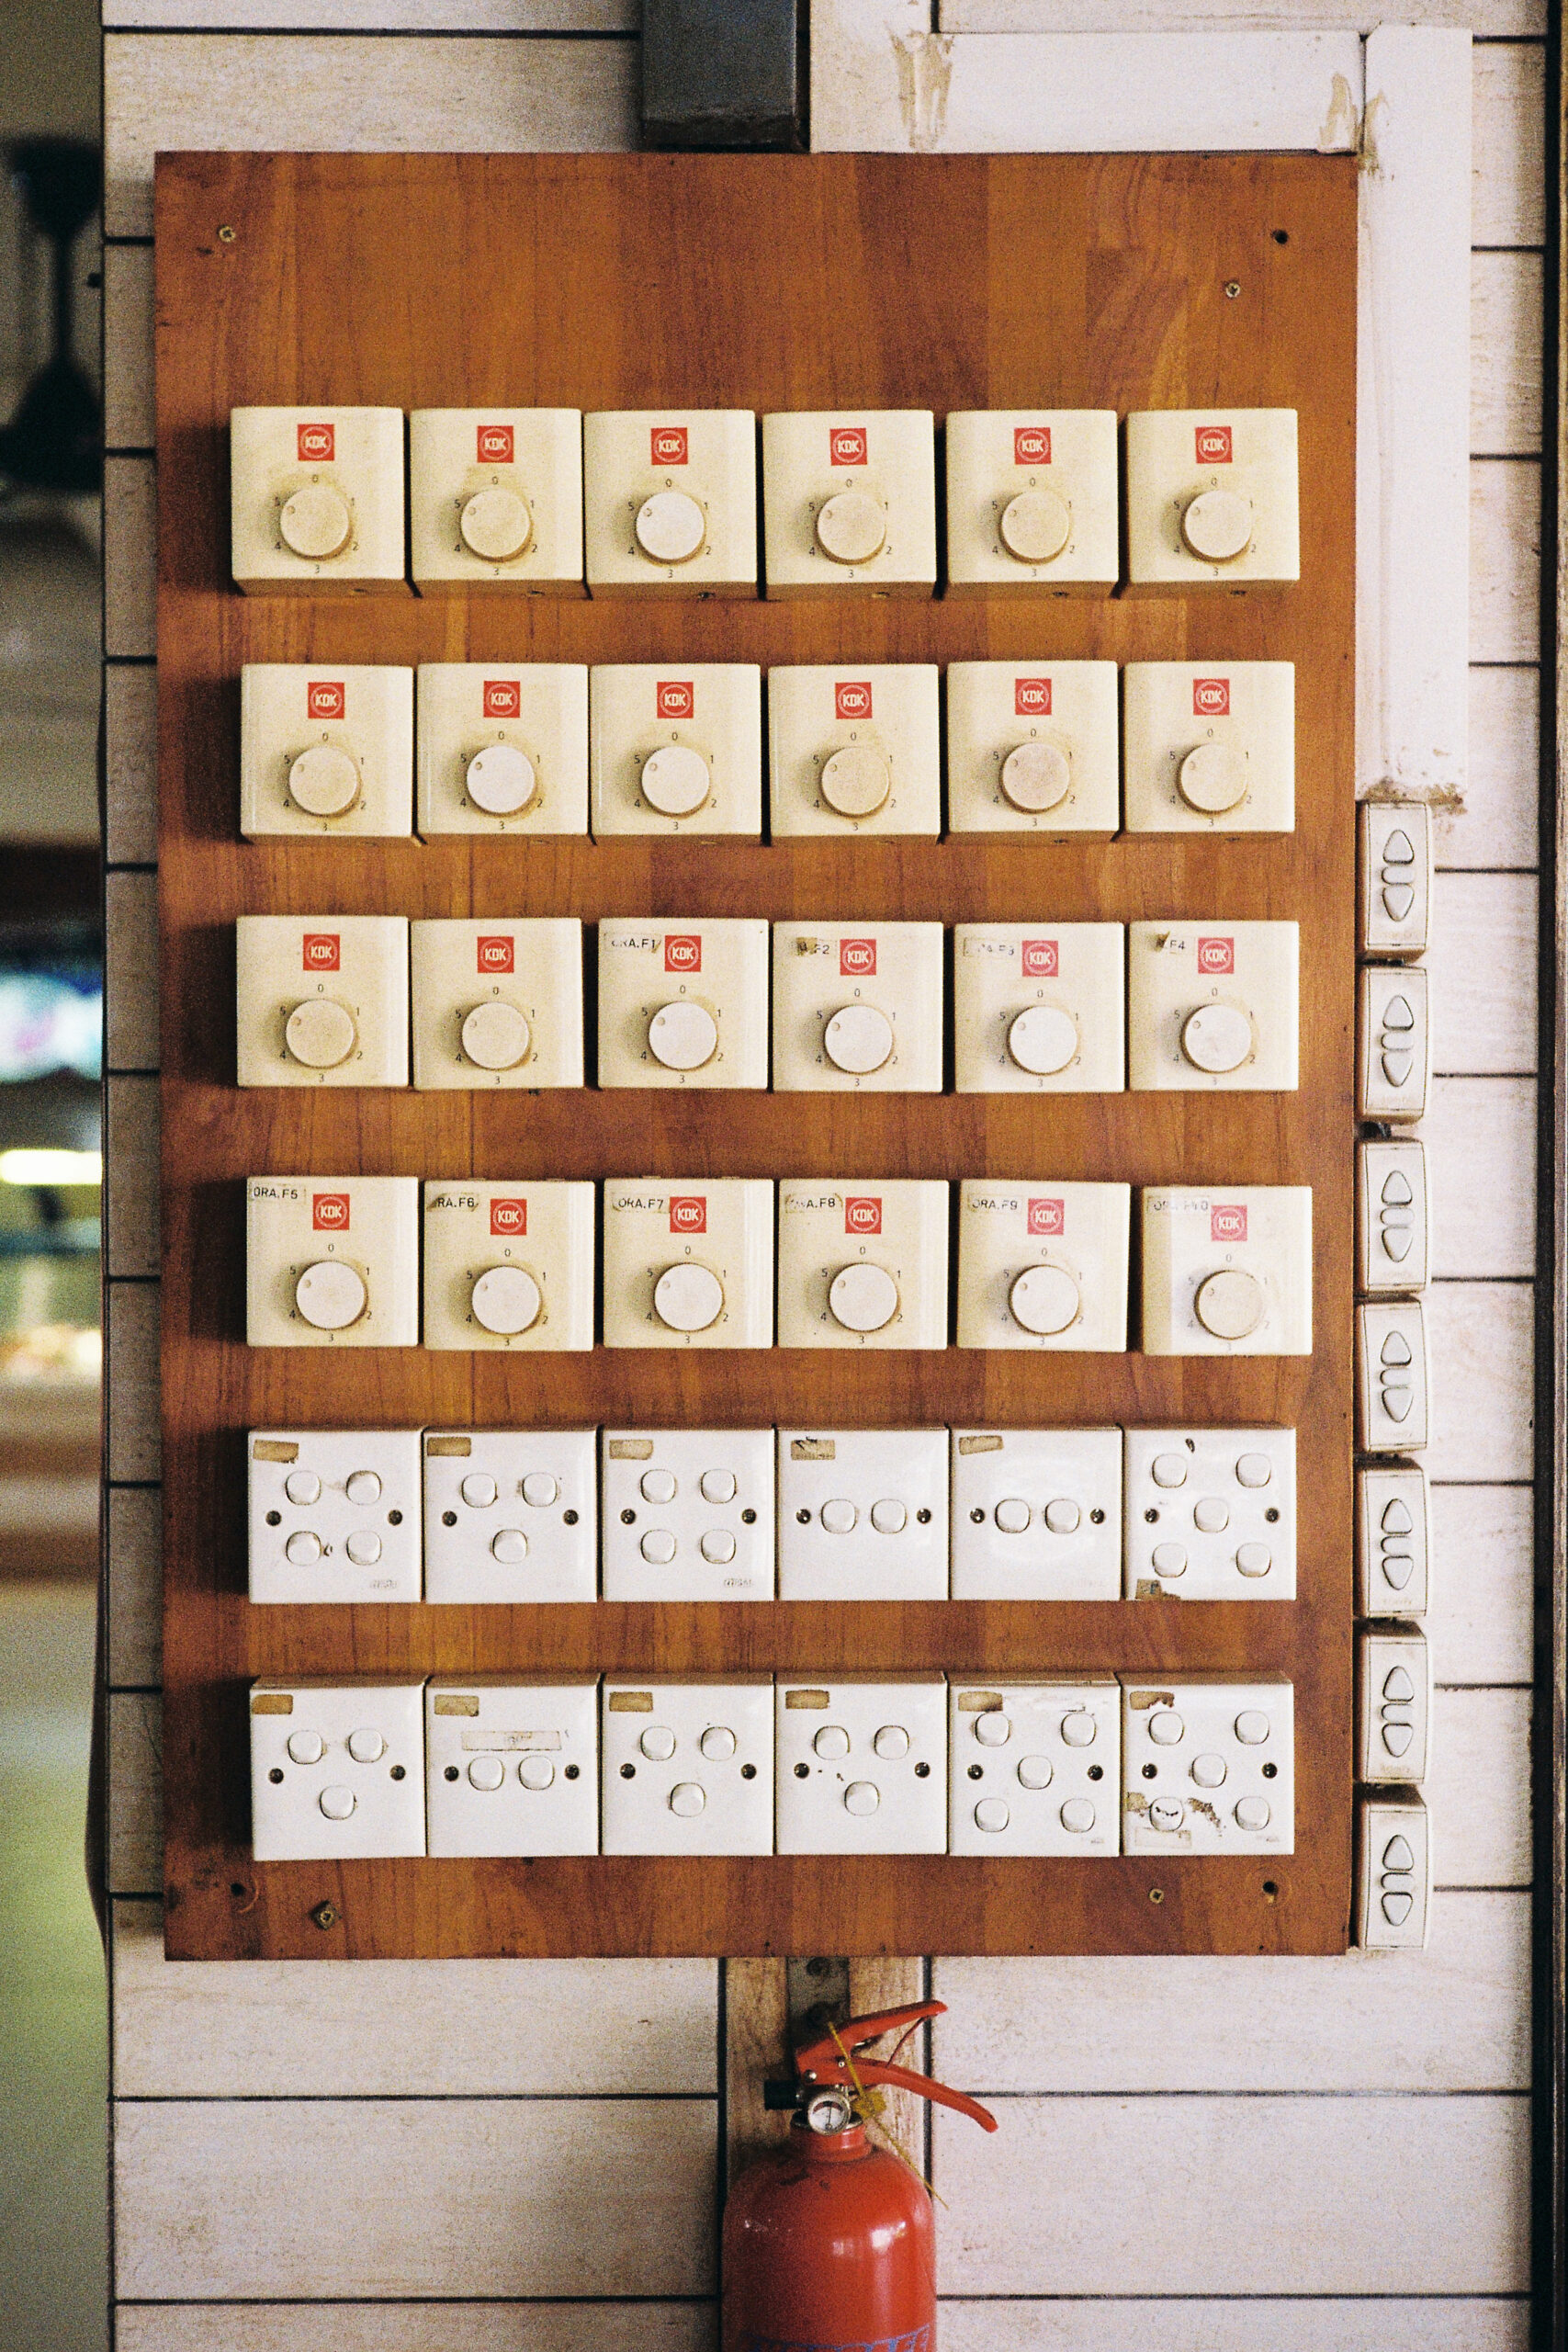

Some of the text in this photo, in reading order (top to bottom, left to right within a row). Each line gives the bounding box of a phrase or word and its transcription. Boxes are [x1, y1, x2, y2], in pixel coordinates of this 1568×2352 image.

[305, 435, 327, 449] KDK
[485, 437, 507, 451] KDK
[658, 439, 680, 453] KDK
[838, 439, 860, 453] KDK
[1021, 439, 1043, 452] KDK
[1203, 437, 1225, 452] KDK
[315, 693, 337, 707] KDK
[491, 692, 513, 706] KDK
[664, 693, 686, 707] KDK
[843, 693, 865, 707] KDK
[1022, 689, 1044, 704] KDK
[1201, 689, 1223, 704] KDK
[310, 944, 333, 959] KDK
[485, 948, 507, 961] KDK
[672, 946, 694, 959] KDK
[847, 950, 869, 964] KDK
[1029, 951, 1051, 965] KDK
[1205, 948, 1227, 963] KDK
[253, 1186, 299, 1200] ORA.F5
[618, 1198, 664, 1210] ORA.F7
[320, 1205, 342, 1218] KDK
[498, 1209, 520, 1224] KDK
[677, 1207, 699, 1222] KDK
[852, 1209, 874, 1222] KDK
[1034, 1209, 1056, 1224] KDK
[1218, 1216, 1240, 1229] KDK
